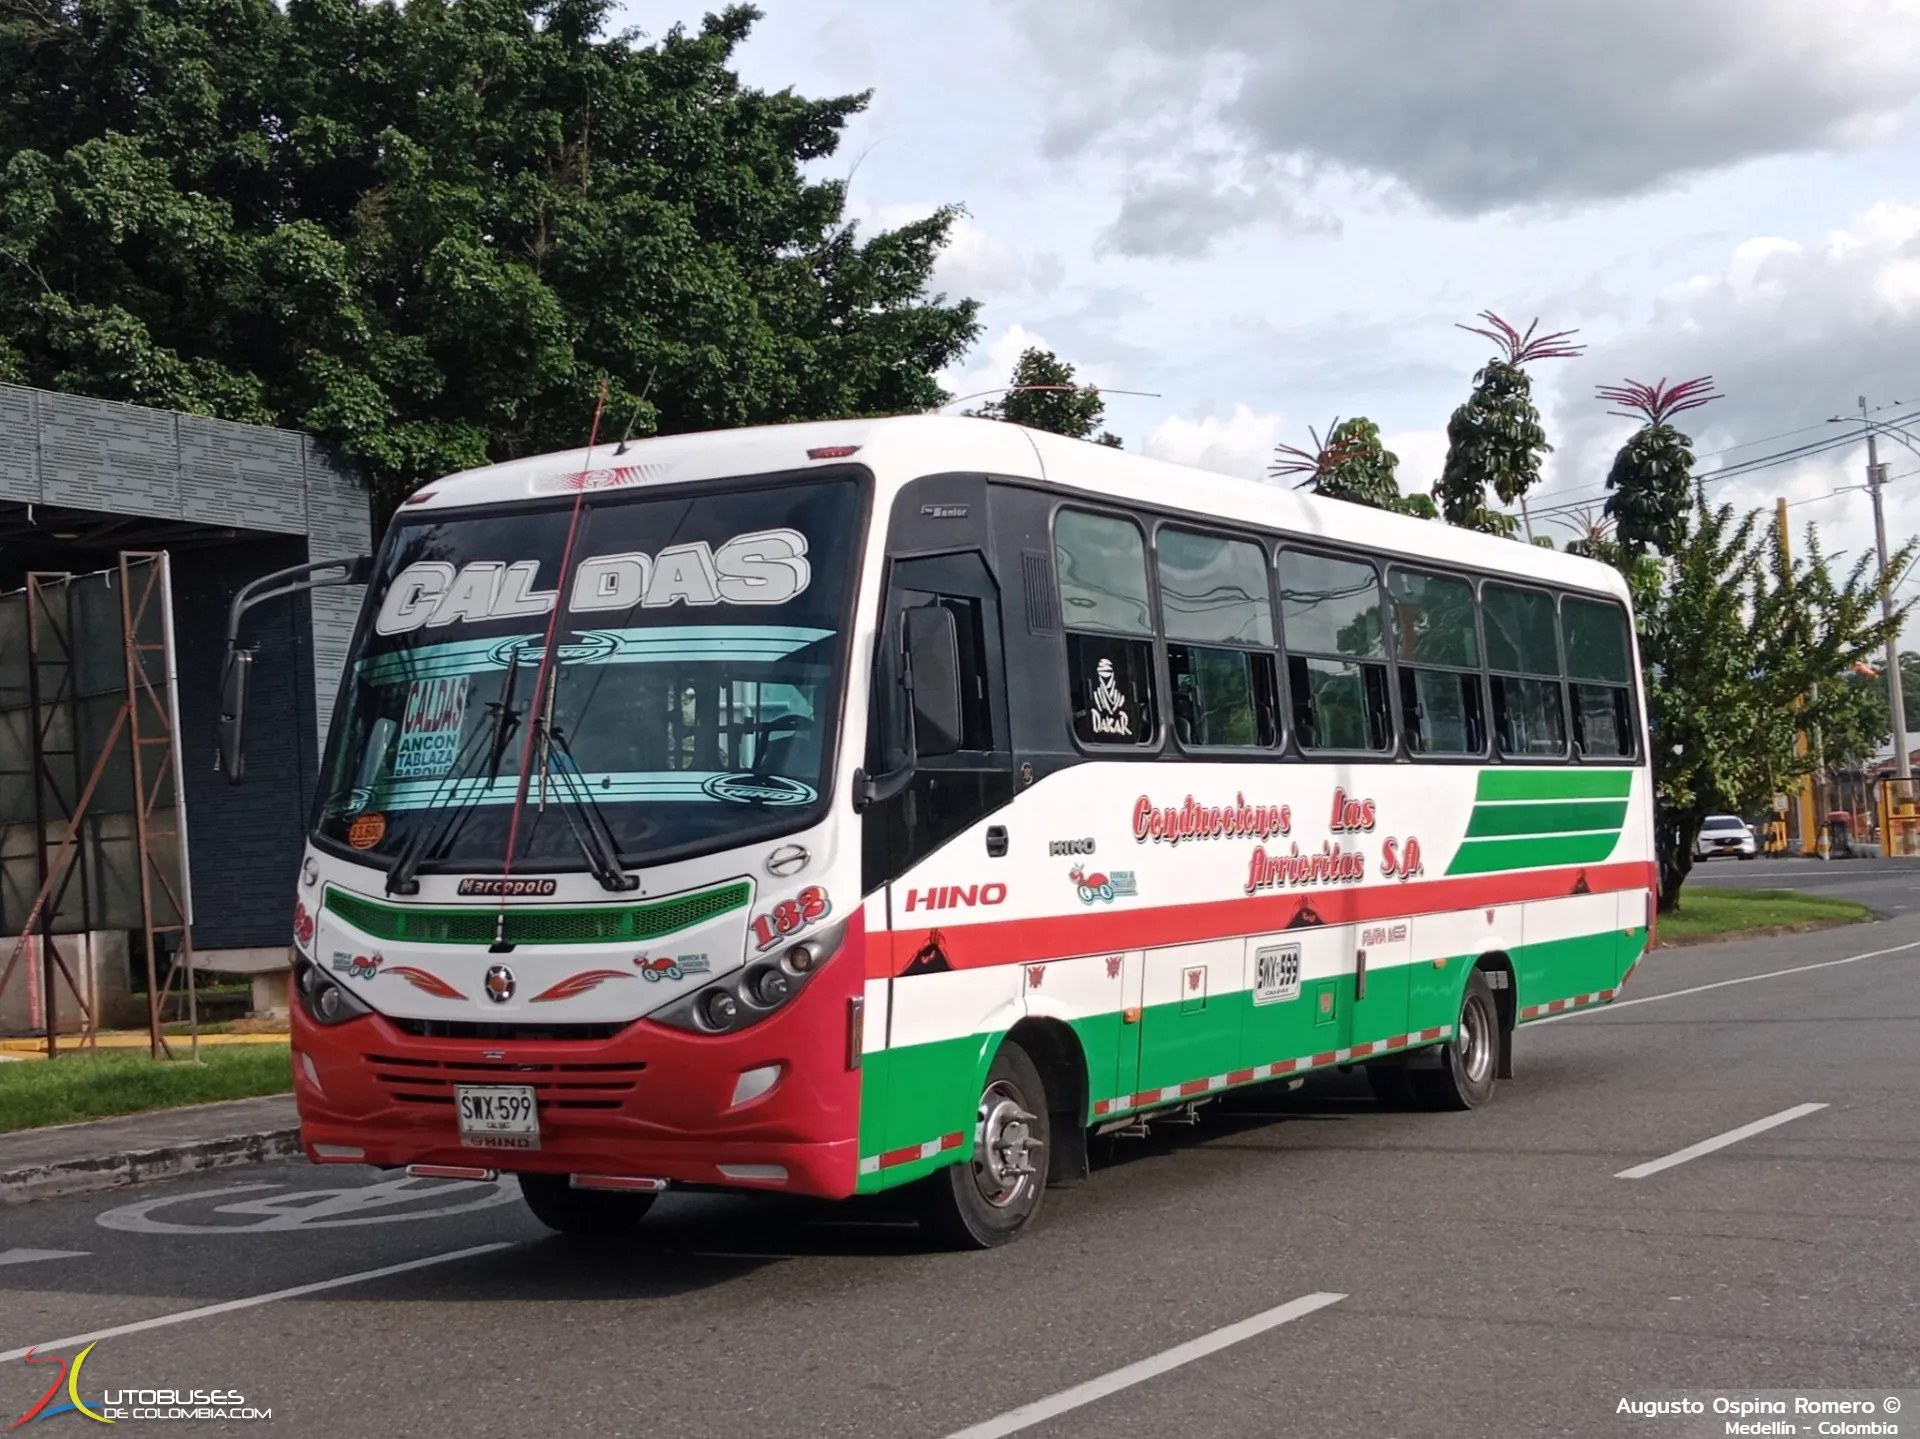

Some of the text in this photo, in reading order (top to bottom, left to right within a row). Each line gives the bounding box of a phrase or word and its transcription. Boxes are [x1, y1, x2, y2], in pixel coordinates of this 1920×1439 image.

[404, 677, 468, 734] CALDAS
[1091, 708, 1132, 735] DAKAR
[400, 734, 457, 752] ANCON
[398, 749, 453, 768] TABLAZA
[1131, 794, 1291, 846] Conducciones
[1049, 837, 1096, 857] HINO
[1244, 839, 1365, 895] Arrieritas
[460, 880, 554, 895] Marcopolo
[905, 883, 1007, 912] HINO
[484, 1136, 530, 1148] HINO
